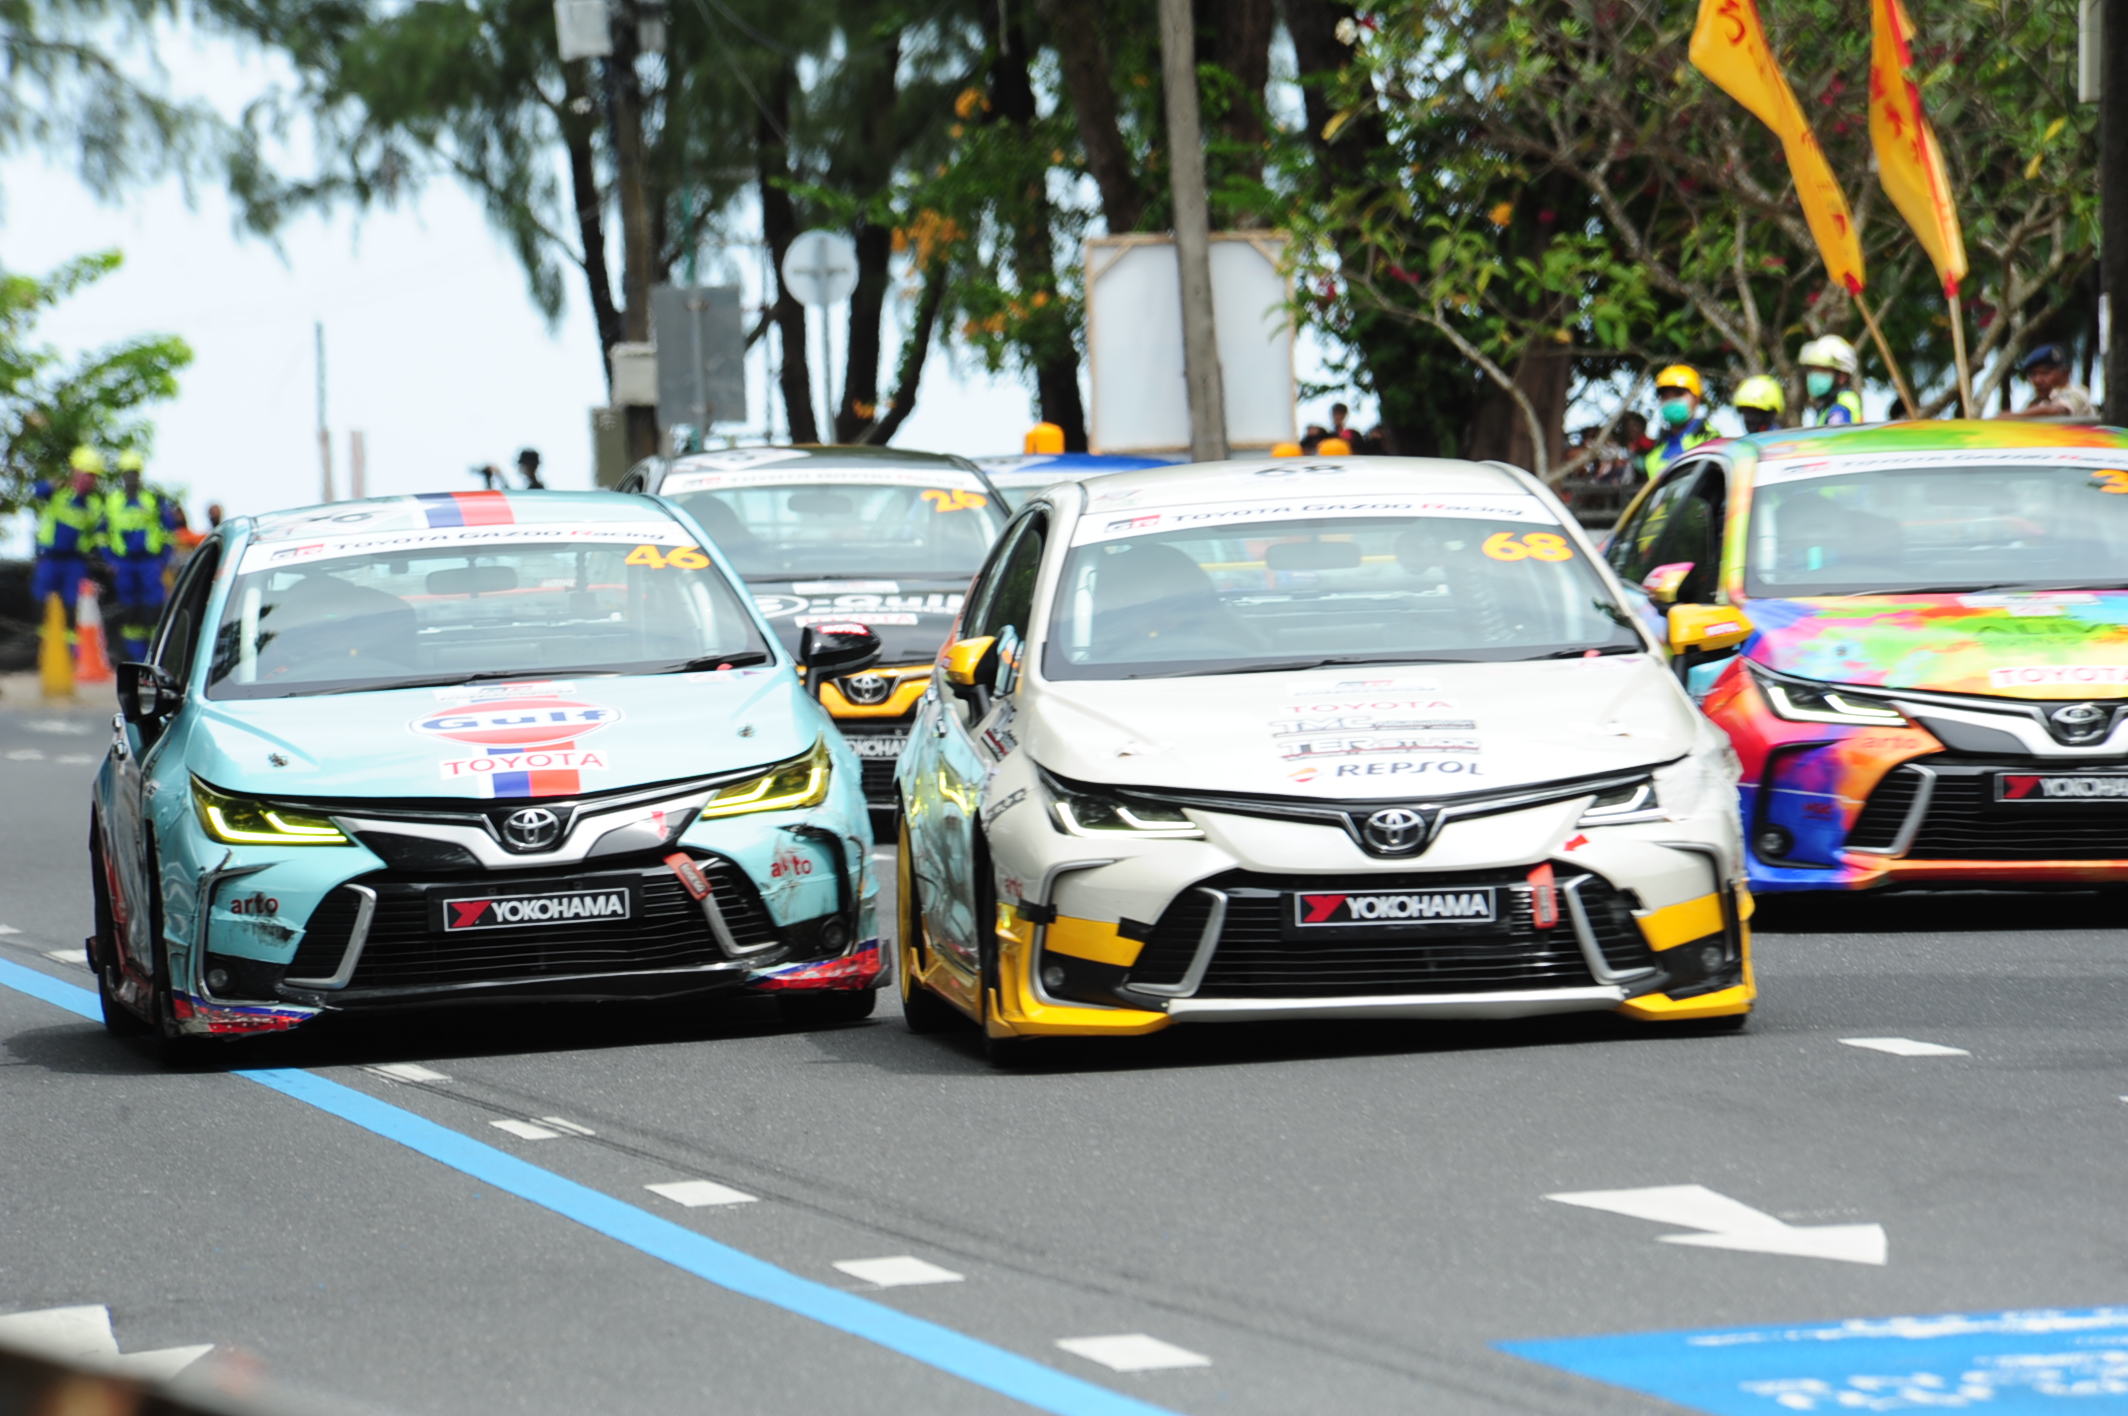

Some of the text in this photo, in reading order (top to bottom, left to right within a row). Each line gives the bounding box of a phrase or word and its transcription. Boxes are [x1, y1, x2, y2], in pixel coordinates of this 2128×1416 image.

[921, 488, 987, 513] 26
[1171, 506, 1291, 522] TOYOTA
[1302, 503, 1412, 512] GAZOO
[1421, 503, 1524, 516] Racing
[335, 534, 449, 550] TOYOTA
[457, 529, 562, 539] GAZOO
[570, 529, 667, 541] Racing
[1481, 532, 1574, 563] 68
[625, 544, 710, 570] 46
[1993, 667, 2128, 684] TOYOT
[421, 709, 610, 730] Gulf
[1286, 701, 1454, 714] TOYOTA
[443, 752, 604, 776] TOYOTA
[1336, 760, 1485, 778] REPSOL
[230, 890, 279, 915] arto
[490, 894, 625, 923] YOKOHAMA
[1345, 893, 1490, 919] YOKOHAMA
